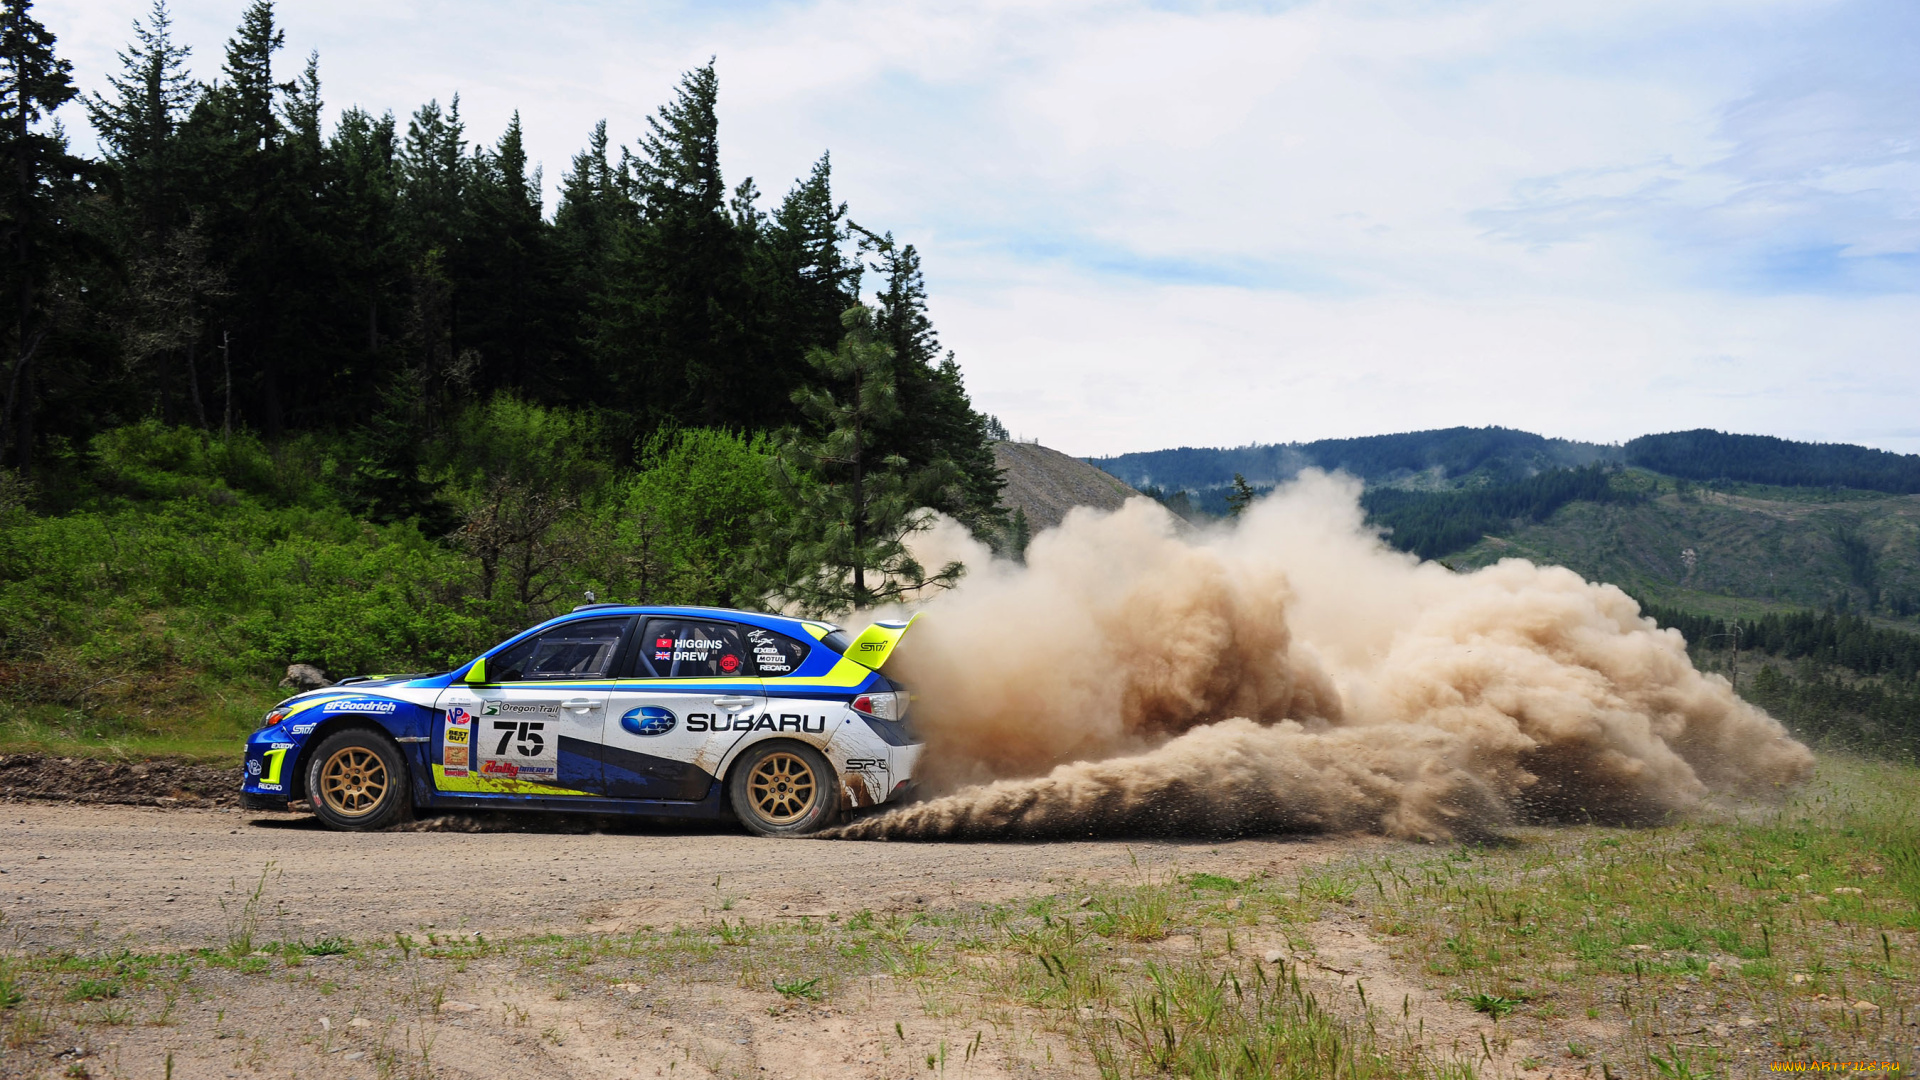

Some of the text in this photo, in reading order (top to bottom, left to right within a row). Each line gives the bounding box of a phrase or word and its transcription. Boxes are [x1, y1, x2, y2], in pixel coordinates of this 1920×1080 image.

[674, 639, 723, 649] HIGGINS
[673, 651, 708, 661] DREW
[324, 701, 396, 711] BFGoodrich
[502, 703, 559, 713] Oregon Trail
[448, 707, 464, 725] VP
[686, 713, 826, 734] SUBARU
[448, 729, 468, 737] BEST
[493, 721, 545, 757] 75
[271, 742, 295, 750] EXEDY
[484, 760, 519, 777] Rally
[258, 782, 283, 791] RECARO
